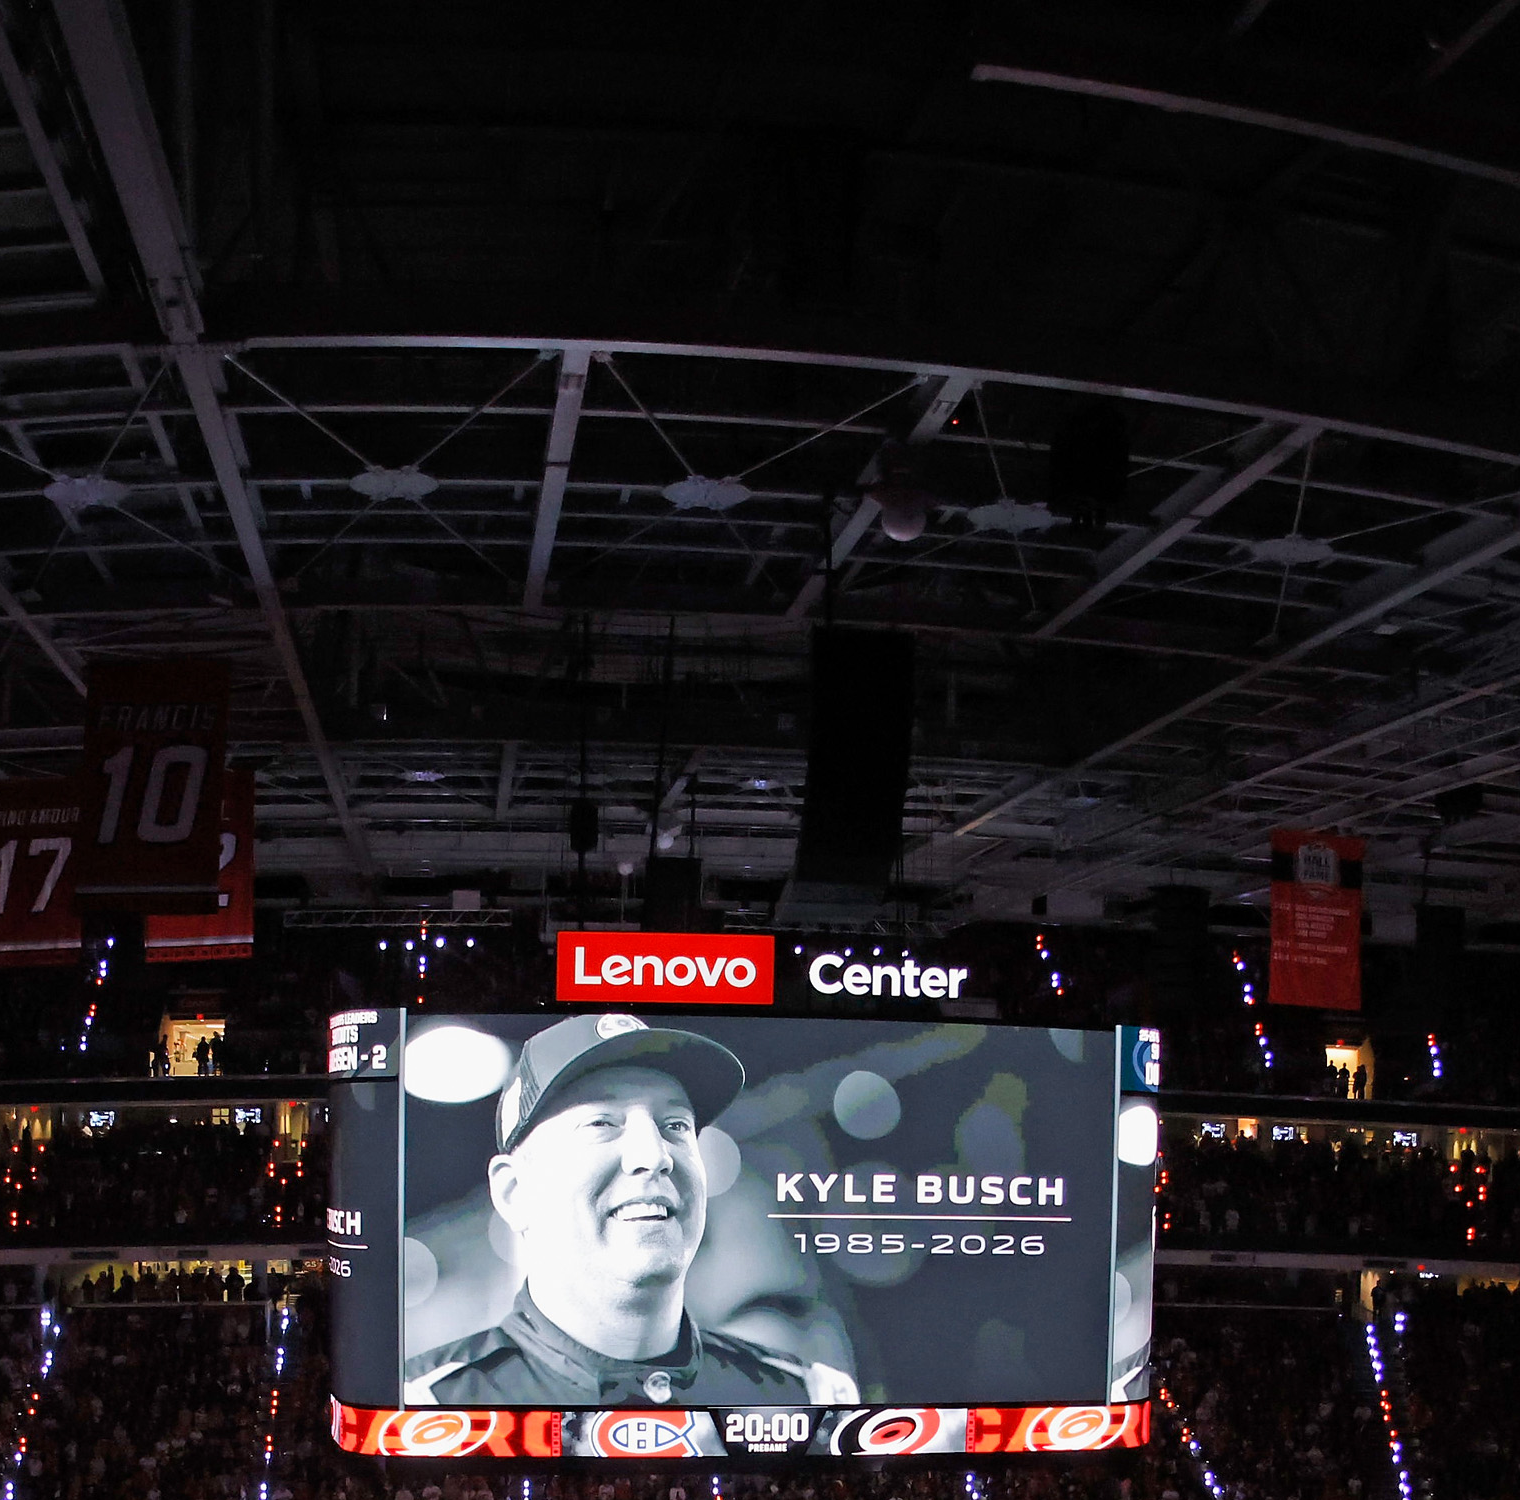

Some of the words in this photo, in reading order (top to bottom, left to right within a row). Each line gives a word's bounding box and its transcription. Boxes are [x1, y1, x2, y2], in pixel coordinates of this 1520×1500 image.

[97, 704, 217, 731] FRANCIS
[97, 744, 210, 844] 10
[573, 946, 758, 990] Lenovo
[808, 953, 969, 999] Center
[372, 1045, 387, 1069] 2
[776, 1172, 897, 1203] KYLE
[916, 1176, 1065, 1208] BUSCH
[793, 1232, 1046, 1257] 1985-2026
[725, 1413, 809, 1443] 20:00
[747, 1443, 789, 1454] PREGAME
